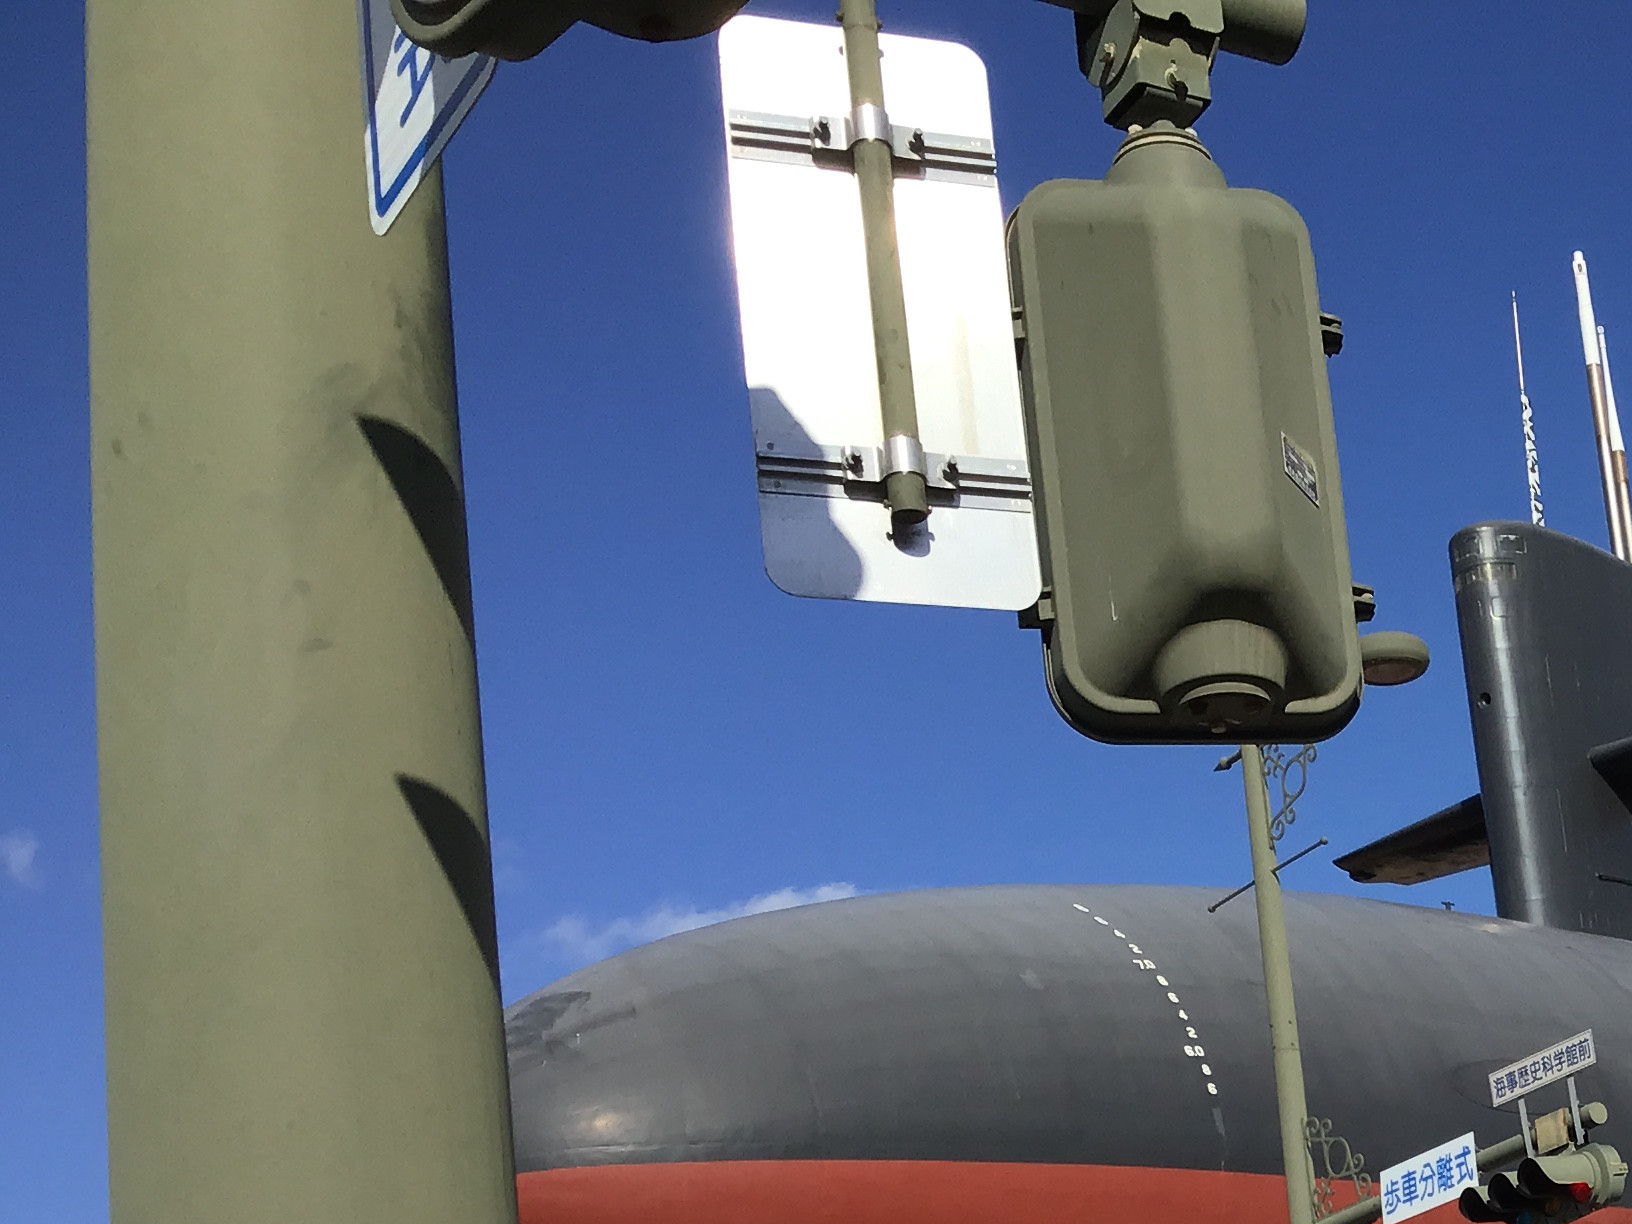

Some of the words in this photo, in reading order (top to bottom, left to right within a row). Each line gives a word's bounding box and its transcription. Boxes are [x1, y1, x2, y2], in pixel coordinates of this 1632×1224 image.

[1493, 1038, 1591, 1099] 海事歴史科学館前
[1384, 1145, 1474, 1215] 歩車分離式
